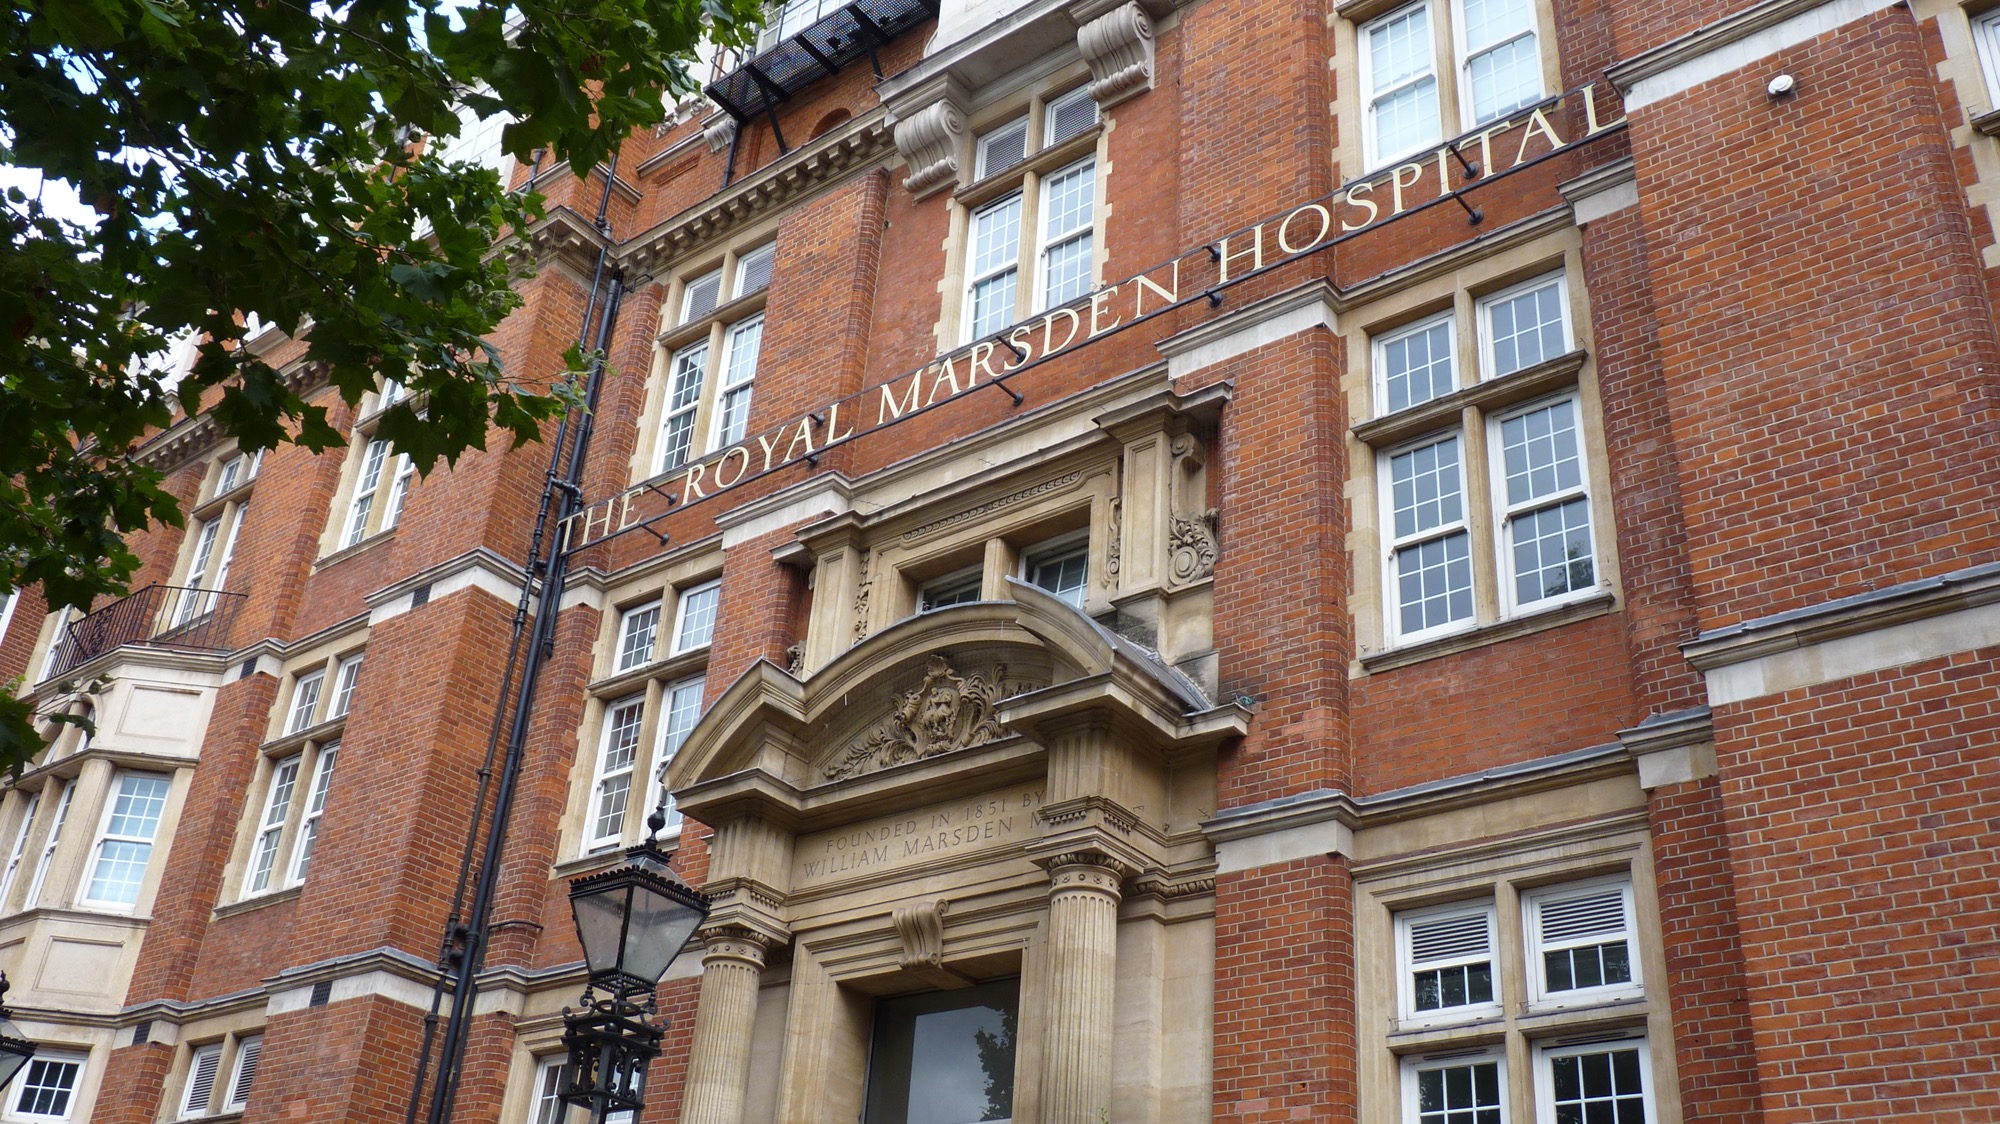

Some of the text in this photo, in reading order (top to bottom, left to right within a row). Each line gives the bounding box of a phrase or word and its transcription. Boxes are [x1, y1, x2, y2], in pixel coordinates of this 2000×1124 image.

[557, 82, 1627, 552] THE ROYAL MARSDEN HOSPITAL
[804, 845, 889, 878] WILLIAM
[903, 817, 1012, 857] MARSDEN
[826, 789, 1045, 853] FOUNDED IN 1851 BY
